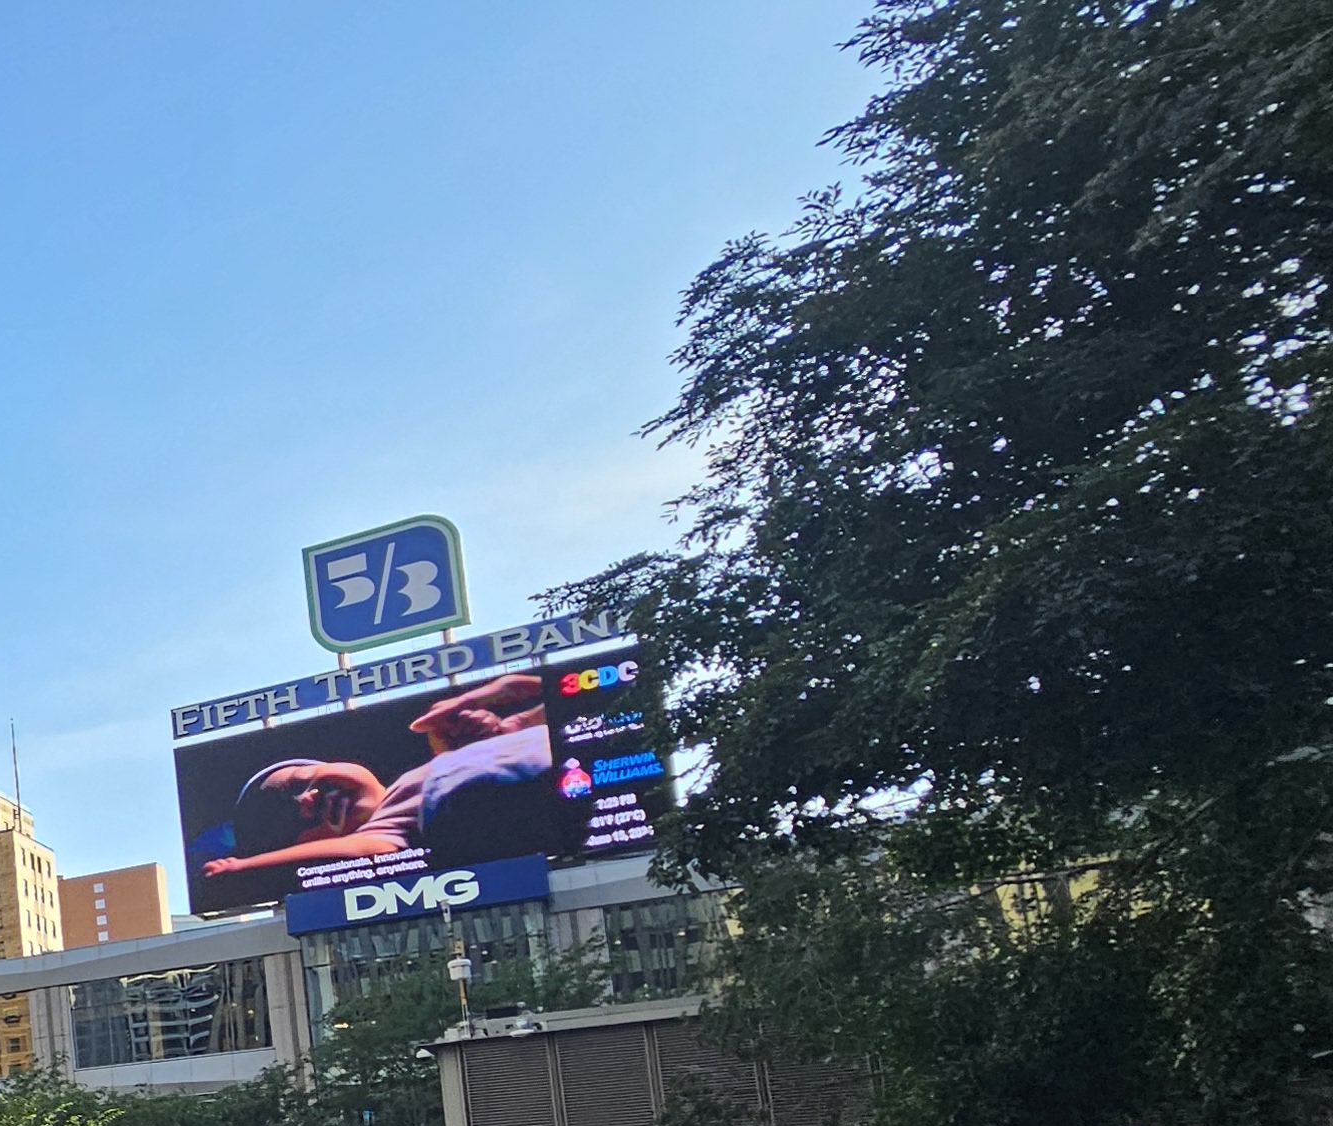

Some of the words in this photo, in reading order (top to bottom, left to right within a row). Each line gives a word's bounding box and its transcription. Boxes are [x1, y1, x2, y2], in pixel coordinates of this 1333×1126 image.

[173, 685, 299, 737] FIFTH
[313, 644, 475, 702] THIRD
[561, 660, 639, 694] 3CDC
[344, 869, 480, 921] DMG
